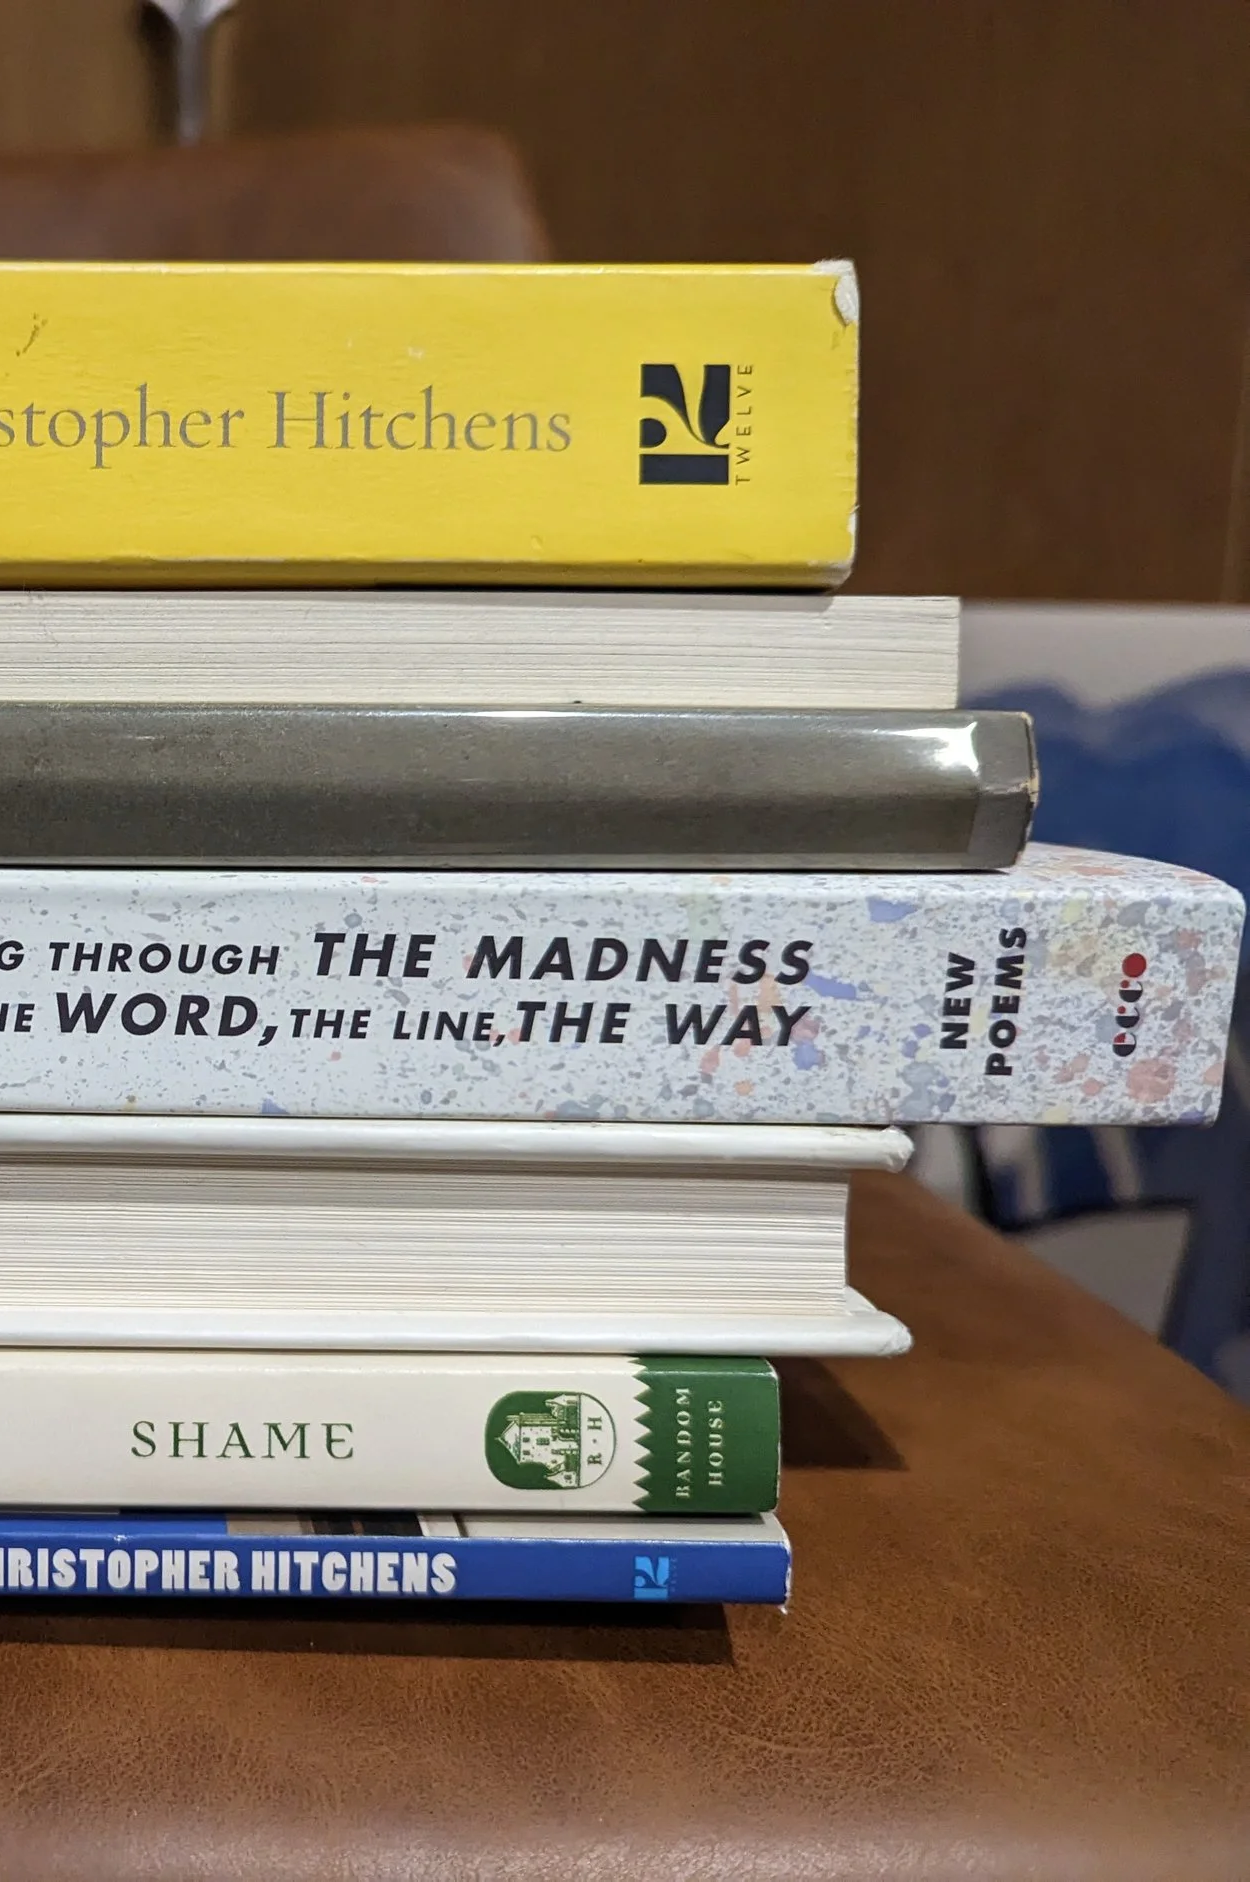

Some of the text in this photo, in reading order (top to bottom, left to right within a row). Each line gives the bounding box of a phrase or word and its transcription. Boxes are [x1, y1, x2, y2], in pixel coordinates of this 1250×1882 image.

[265, 388, 572, 453] Hitchens
[735, 364, 753, 486] TWELVE
[48, 941, 280, 977] THROUGH
[311, 932, 435, 980] THE
[465, 936, 814, 985] MADNESS
[56, 991, 278, 1046] WORD,
[290, 1008, 371, 1040] THE
[392, 1010, 507, 1048] LINE,
[515, 1000, 627, 1046] THE
[663, 1003, 812, 1050] WAY
[939, 952, 975, 1049] NEW
[984, 927, 1027, 1076] POEMS
[130, 1421, 355, 1460] SHAME
[675, 1388, 693, 1498] RANDOM
[707, 1401, 725, 1486] HOUSE
[251, 1549, 457, 1594] HITCHENS
